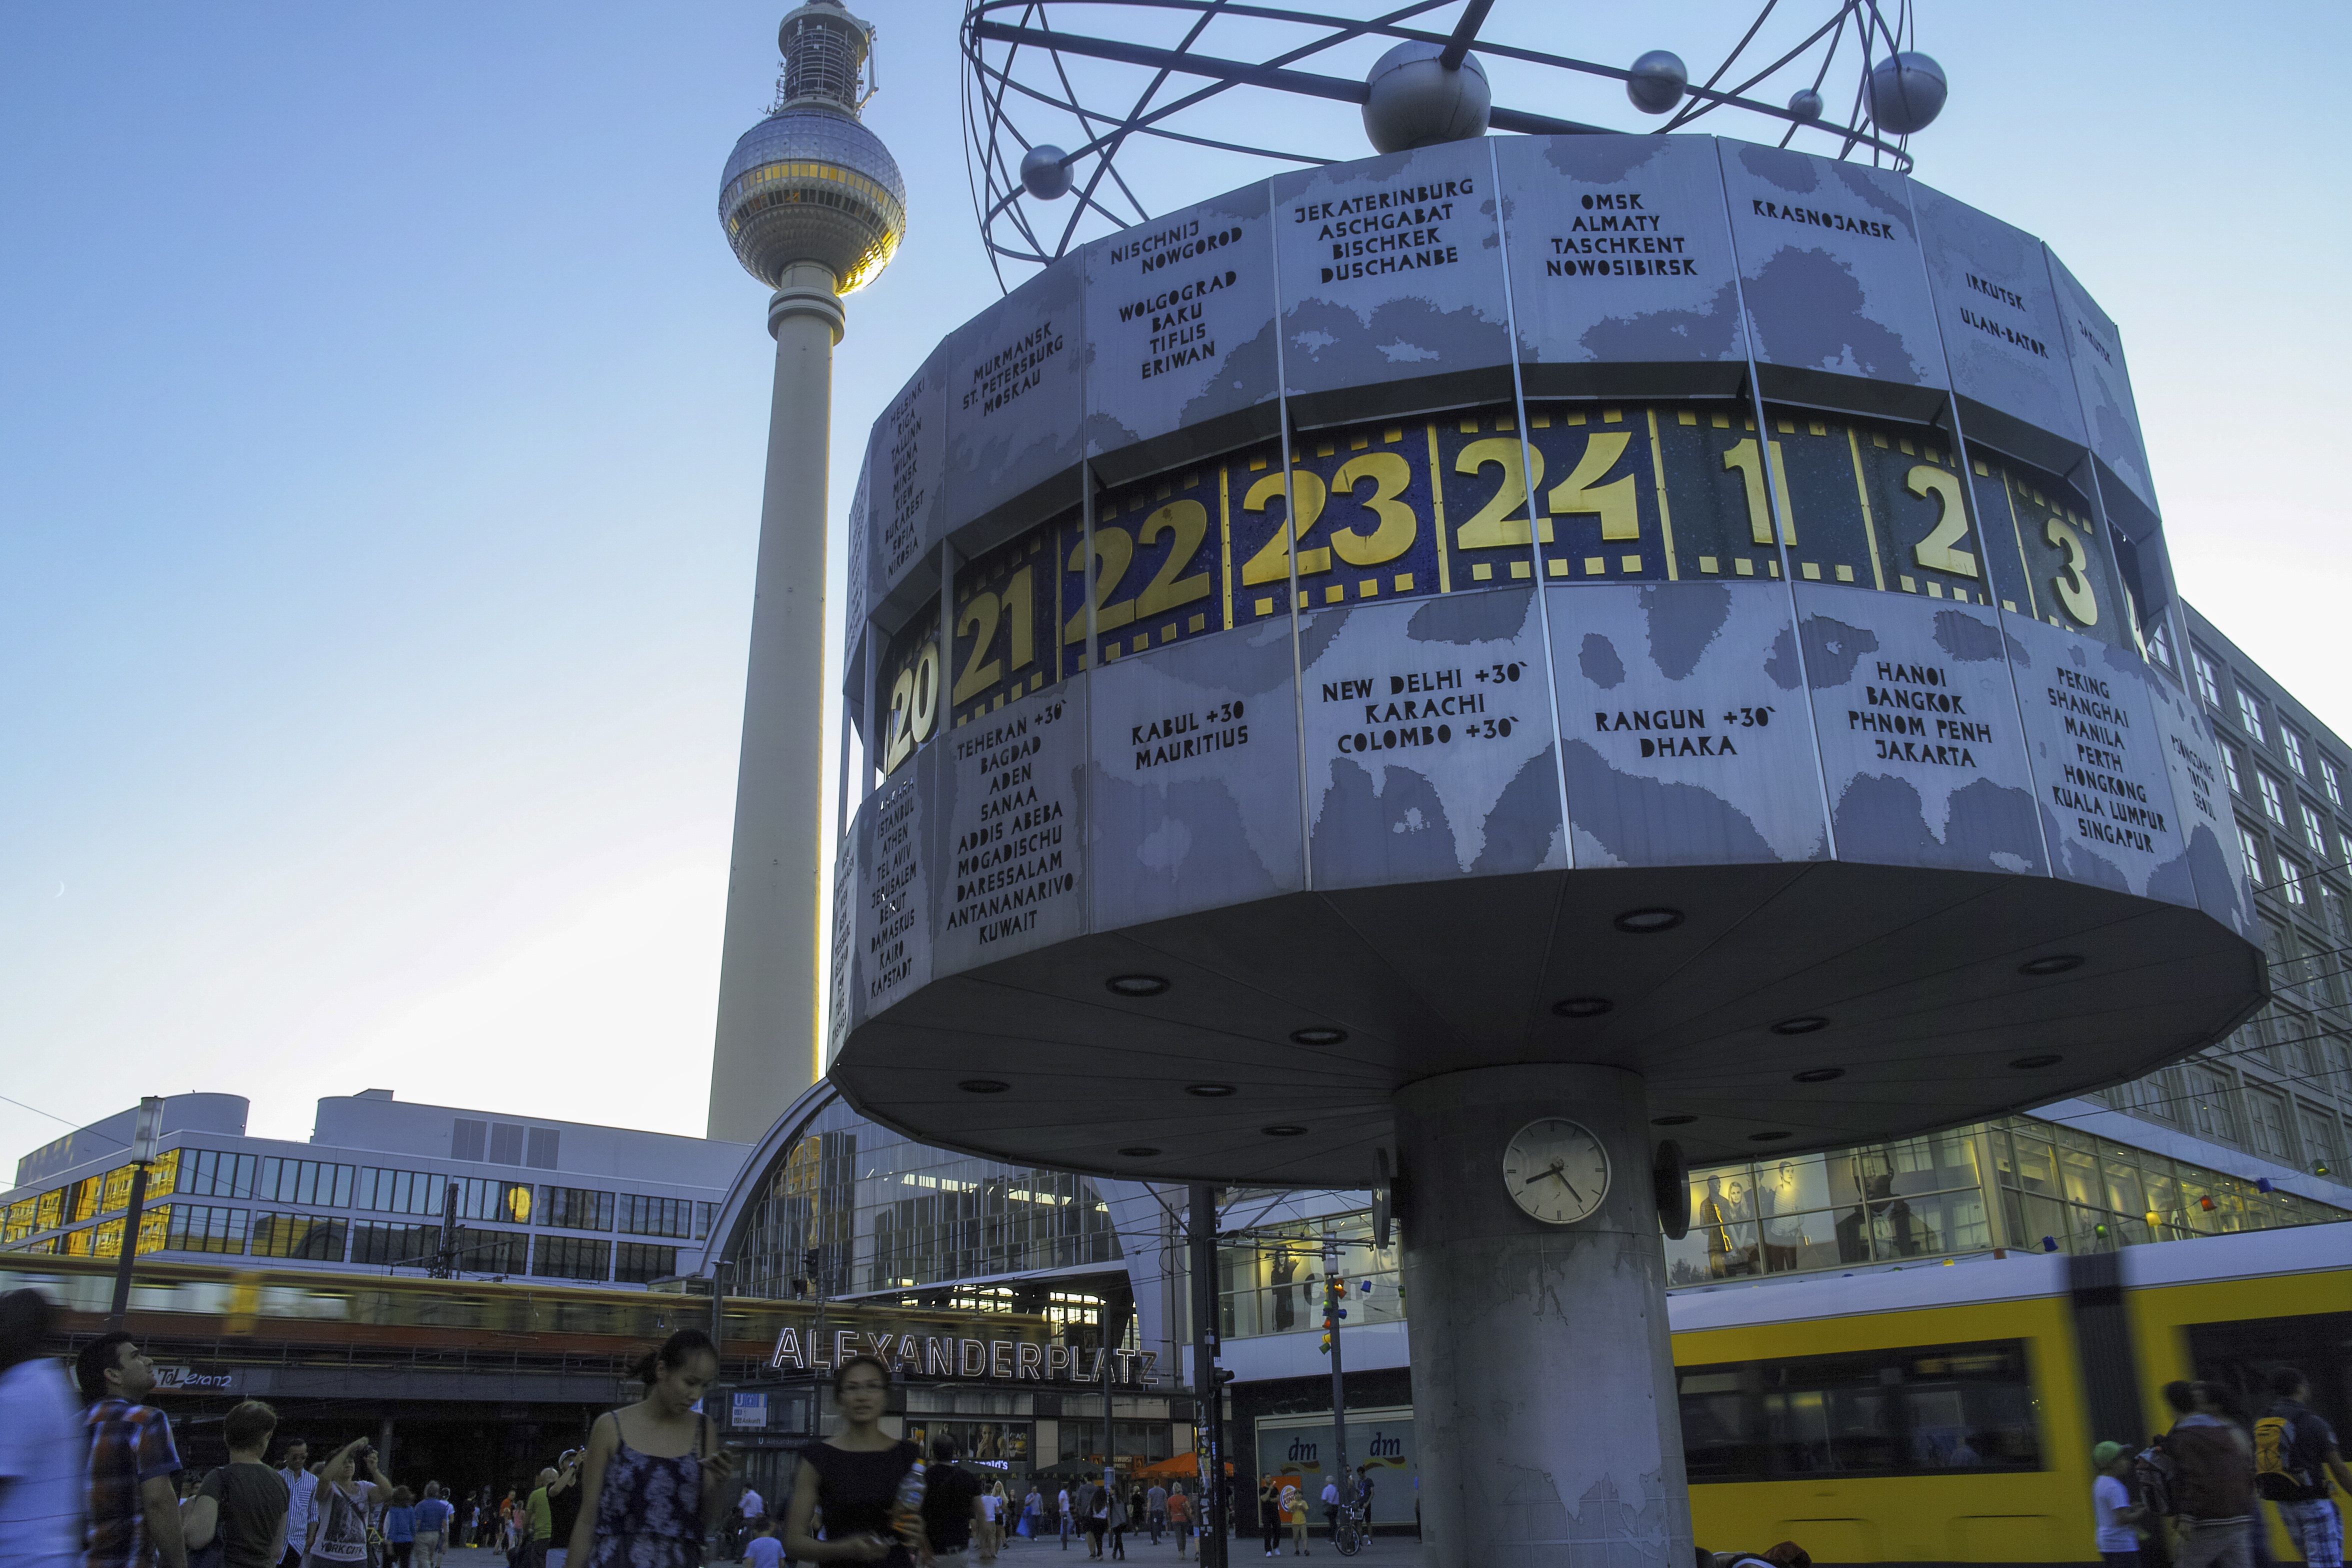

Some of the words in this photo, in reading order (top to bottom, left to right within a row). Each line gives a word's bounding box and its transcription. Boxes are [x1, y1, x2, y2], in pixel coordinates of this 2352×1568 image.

[1295, 178, 1474, 223] JEKATERINBURG
[1581, 194, 1644, 210] OMSK
[1752, 200, 1896, 240] KRASNOJARSK
[1111, 220, 1200, 265] NISCHNIJ
[1318, 204, 1453, 241] ASCHGABAT
[1571, 216, 1660, 232] ALMATY
[1142, 227, 1242, 274] NOWGOROD
[1332, 227, 1442, 260] BISCHKEK
[1552, 238, 1684, 254] TASCHKENT
[1321, 246, 1458, 284] DUSCHANBE
[1546, 260, 1698, 276] NOWOSIBIRSK
[1119, 270, 1236, 322] WOLGOGRAD
[1966, 272, 2026, 312] IRKUTSK
[1152, 302, 1202, 333] BAKU
[1960, 308, 2049, 359] ULAN-BATOR
[974, 321, 1052, 384] MURMANSK
[1150, 323, 1206, 354] TIFLIS
[964, 390, 978, 410] ST.
[982, 334, 1063, 398] PETERSBURG
[1142, 341, 1215, 380] ERIWAN
[890, 376, 924, 428] HELSINKI
[984, 368, 1040, 416] MOSKAU
[892, 416, 922, 462] TALLINN
[898, 408, 915, 437] RIGA
[893, 458, 917, 498] MINSK
[894, 442, 918, 478] WILNA
[896, 482, 914, 514] KIEW
[1455, 431, 1640, 550] 24
[1724, 438, 1798, 546] 1
[886, 489, 924, 544] BUKAREST
[1242, 452, 1416, 586] 23
[1905, 464, 1978, 578] 2
[888, 536, 918, 579] NIKOSIA
[893, 521, 914, 555] SOFIA
[1064, 500, 1210, 646] 22
[2046, 517, 2098, 627] 3
[952, 564, 1034, 707] 21
[1322, 678, 1374, 702] NEW
[1390, 668, 1462, 694] DELHI
[1876, 662, 1946, 687] HANOI
[2056, 667, 2110, 699] PEKING
[888, 641, 938, 776] 20
[1365, 693, 1485, 724] KARACHI
[1595, 709, 1706, 731] RANGUN
[1866, 686, 1966, 715] BANGKOK
[2048, 688, 2129, 728] SHANGHAI
[958, 716, 1027, 760] TEHERAN
[1132, 712, 1199, 746] KABUL
[1206, 700, 1244, 723] +30
[1338, 724, 1451, 754] COLOMBO
[1848, 710, 1926, 736] PHNOM
[1936, 719, 1992, 743] PENH
[2064, 716, 2125, 750] MANILA
[980, 736, 1041, 775] BAGDAD
[1136, 725, 1248, 770] MAURITIUS
[1640, 736, 1738, 757] DHAKA
[1875, 740, 1977, 768] JAKARTA
[2076, 743, 2124, 772] PERTH
[879, 776, 914, 818] ANKARA
[989, 762, 1032, 795] ADEN
[2064, 764, 2146, 803] HONGKONG
[878, 796, 914, 840] ISTANBUL
[981, 786, 1038, 822] SANAA
[2052, 786, 2106, 817] KUALA
[2109, 800, 2167, 832] LUMPUR
[2193, 790, 2216, 822] SEOUL
[882, 822, 908, 858] ATHEN
[958, 822, 1003, 855] ADDIS
[1011, 800, 1063, 835] ABEBA
[2078, 818, 2154, 854] SINGAPUR
[877, 860, 890, 883] TEL
[892, 842, 912, 872] AVIV
[958, 824, 1062, 878] MOGADISCHU
[872, 860, 916, 909] JERUSALEM
[956, 850, 1062, 902] DARESSALAM
[880, 892, 906, 925] BEIRUT
[946, 872, 1073, 931] ANTANANARIVO
[872, 908, 914, 954] DAMASKUS
[979, 910, 1037, 945] KUWAIT
[880, 940, 904, 970] KAIRO
[871, 957, 912, 999] KAPSTADT
[772, 1328, 1158, 1384] ALEXANDERPLATZ
[1288, 1436, 1317, 1462] dm
[1370, 1432, 1400, 1457] dm
